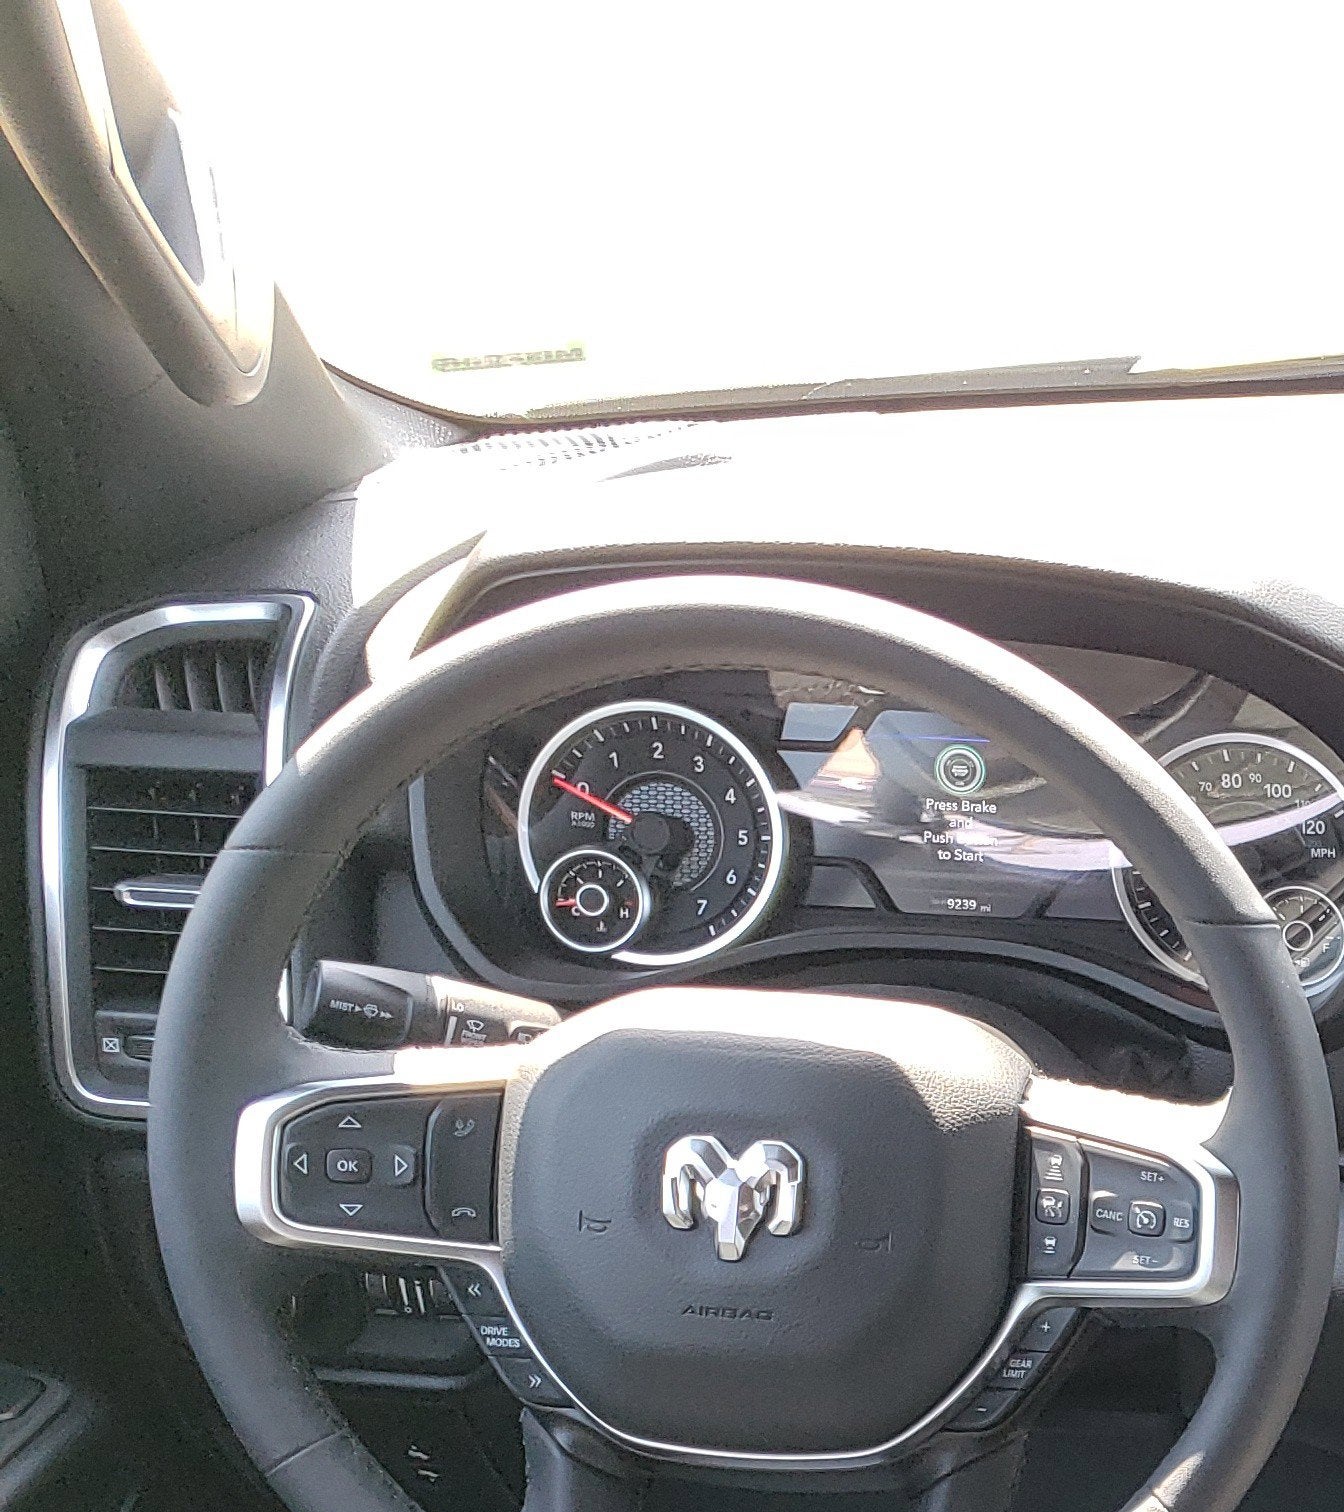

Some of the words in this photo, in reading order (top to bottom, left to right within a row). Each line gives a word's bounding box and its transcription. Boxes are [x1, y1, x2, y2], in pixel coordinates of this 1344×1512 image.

[652, 742, 665, 759] 2
[609, 752, 618, 768] 1
[694, 756, 705, 772] 3
[1221, 773, 1243, 789] 80
[1249, 773, 1262, 784] 90
[1199, 781, 1212, 792] 70
[1263, 784, 1292, 798] 100
[725, 789, 736, 804] 4
[926, 798, 958, 811] Press
[962, 800, 997, 814] Brake
[571, 811, 595, 821] RPM
[949, 816, 974, 829] and
[1302, 820, 1326, 835] 120
[738, 830, 748, 846] 5
[923, 831, 953, 844] Push
[937, 849, 951, 860] to
[954, 849, 985, 863] Start
[1311, 848, 1336, 858] MPH
[726, 869, 737, 885] 6
[697, 899, 708, 915] 7
[947, 899, 976, 911] 9239
[980, 904, 991, 912] mi
[619, 908, 629, 918] H
[329, 1000, 355, 1012] MIST
[451, 1001, 465, 1012] LO
[337, 1160, 359, 1173] OK
[1095, 1208, 1123, 1222] CANC
[1173, 1217, 1190, 1229] RES
[681, 1304, 775, 1321] AIRBAG
[480, 1326, 509, 1336] DRIVE
[486, 1338, 521, 1348] MODES
[1009, 1359, 1033, 1368] GEAR
[1002, 1370, 1026, 1379] LIMIT
